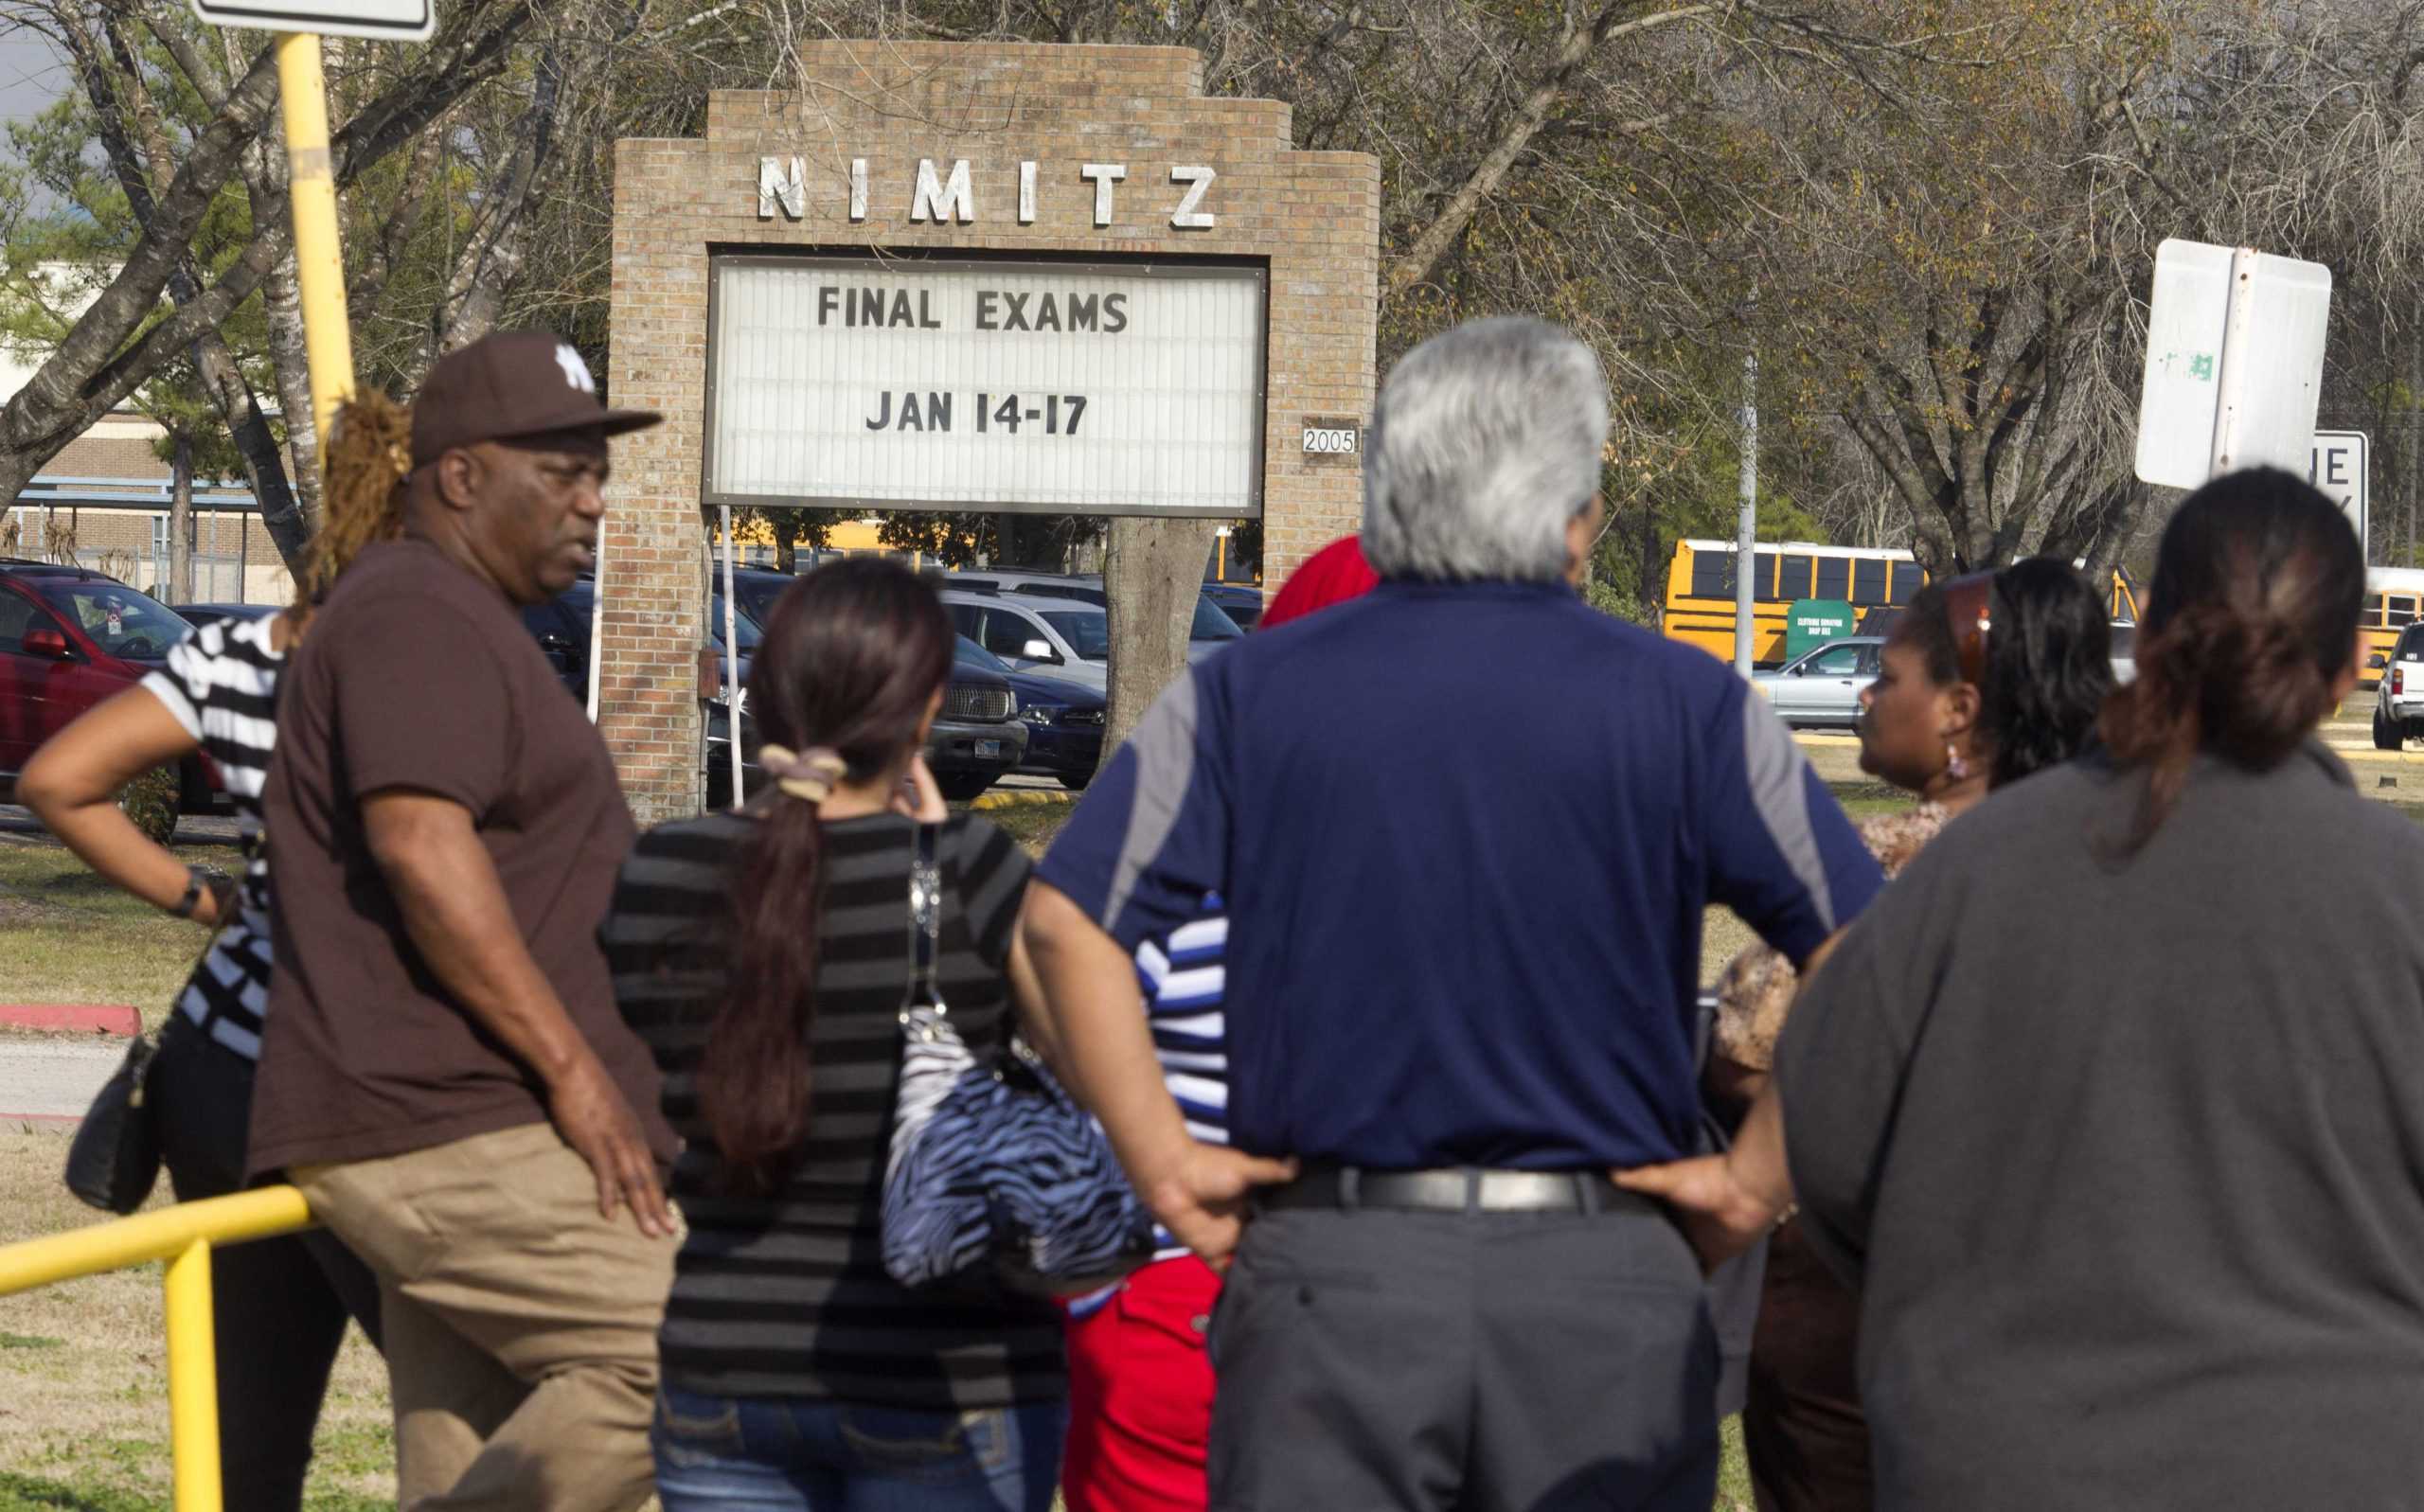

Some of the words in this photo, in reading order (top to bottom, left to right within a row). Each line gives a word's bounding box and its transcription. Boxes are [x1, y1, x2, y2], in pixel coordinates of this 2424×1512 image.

[759, 157, 1217, 228] NIMITZ
[818, 286, 941, 329] FINAL
[975, 291, 1129, 333] EXAMS
[865, 391, 953, 432] JAN
[976, 393, 1088, 436] 14-17
[1305, 430, 1354, 452] 2005
